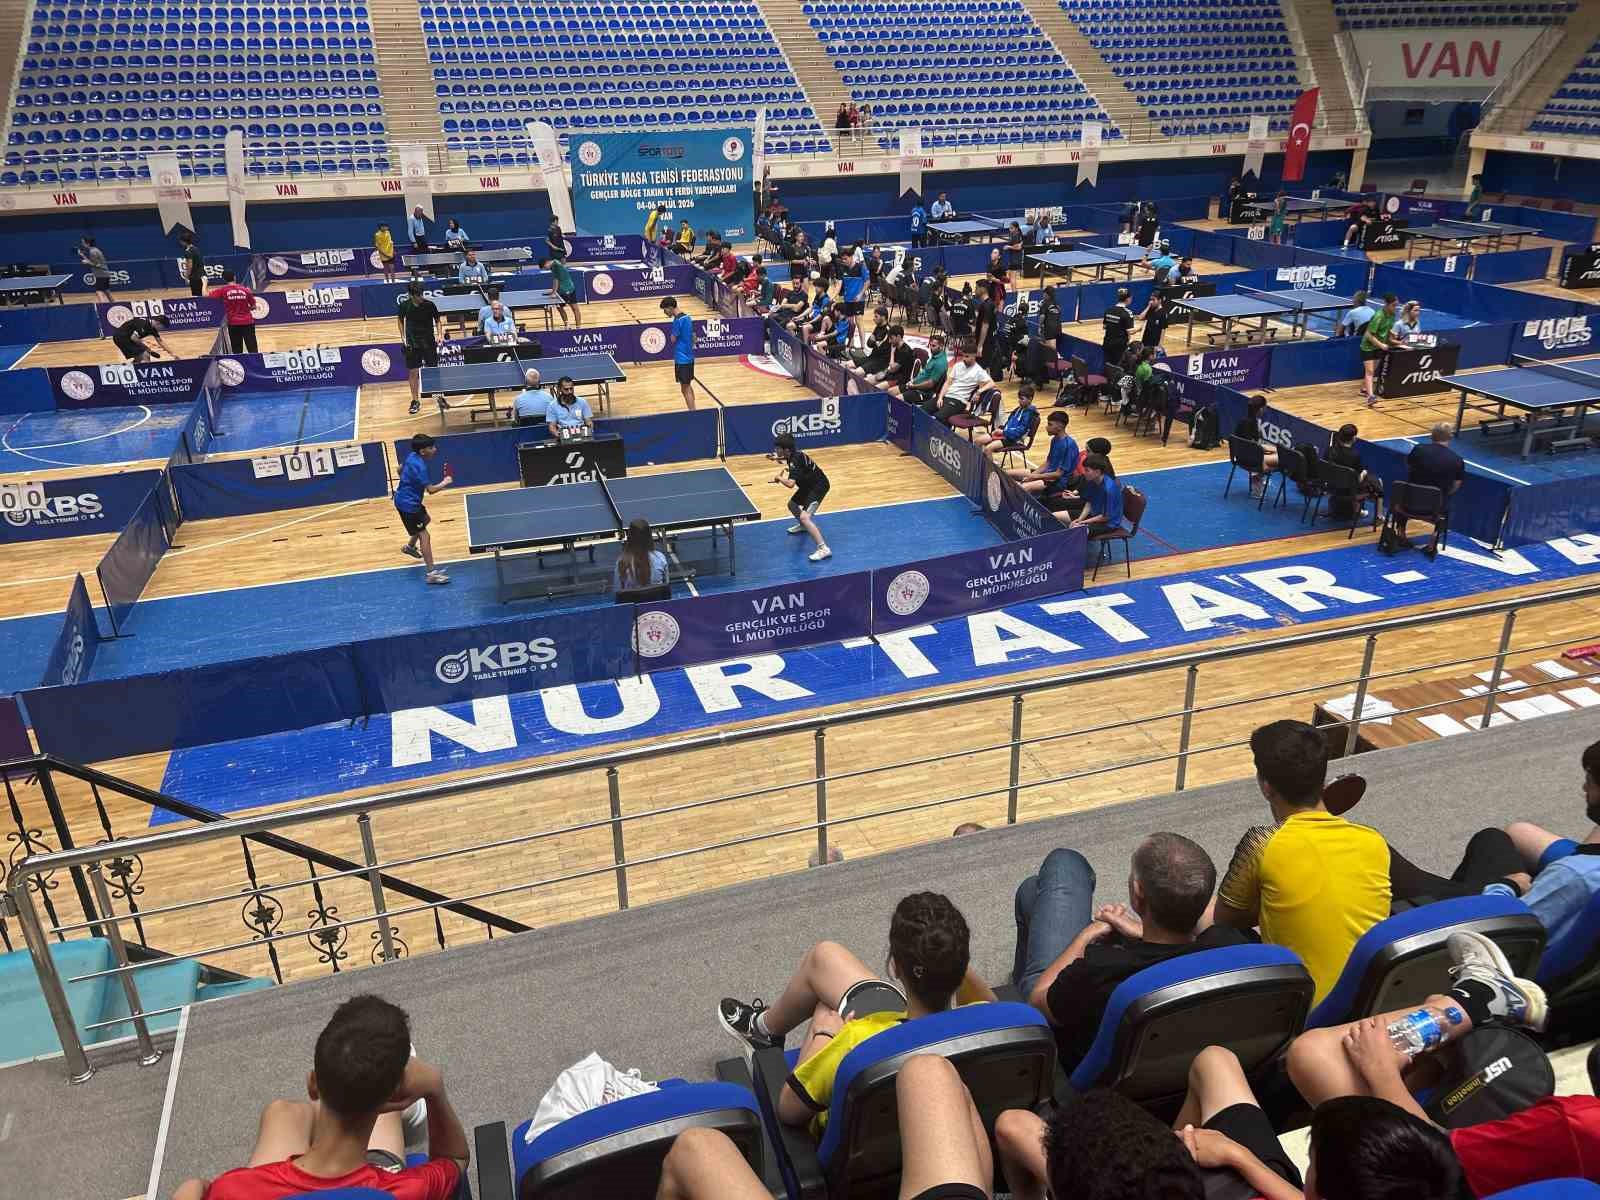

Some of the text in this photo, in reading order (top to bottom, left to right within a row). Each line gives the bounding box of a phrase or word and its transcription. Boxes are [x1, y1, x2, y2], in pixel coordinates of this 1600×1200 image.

[1401, 40, 1501, 78] VAN
[1212, 144, 1227, 153] VAN
[997, 155, 1012, 164] VAN
[838, 162, 854, 172] VAN
[480, 177, 499, 187] VAN
[581, 167, 743, 186] TÜRKİYE MASA TENİSİ FEDERASYONU
[276, 184, 298, 195] VAN
[381, 180, 401, 191] VAN
[591, 184, 737, 201] GENÇLER BÖLGE TAKIM VE FERDİ YARIŞMALARI
[54, 192, 78, 205] VAN
[637, 201, 656, 211] 04-06
[679, 200, 695, 209] 2026
[307, 293, 317, 305] 0
[322, 292, 331, 304] 0
[135, 304, 160, 315] 0 0
[168, 301, 197, 312] VAN
[709, 324, 720, 335] 10
[573, 333, 603, 345] VAN
[728, 334, 745, 345] SPOR
[560, 343, 618, 354] GENÇLİK VE SPOR
[287, 356, 298, 369] 0
[306, 355, 317, 368] 0
[1190, 359, 1201, 373] 5
[1209, 356, 1239, 370] VAN
[105, 368, 134, 383] 0 0
[137, 367, 174, 379] VAN
[285, 371, 334, 382] MÜDÜRLÜĞÜ
[1223, 371, 1232, 379] VE
[1401, 369, 1441, 385] STIGA
[160, 378, 171, 387] VE
[172, 377, 193, 387] SPOR
[128, 384, 190, 396] İL MÜDÜRLÜĞÜ
[826, 403, 836, 417] 9
[936, 441, 961, 471] KBS
[290, 456, 302, 472] 0
[316, 457, 328, 473] 1
[2, 490, 42, 509] 0 0
[35, 493, 104, 519] KBS
[989, 547, 1033, 570] VAN
[966, 561, 1053, 589] GENÇLİK VE SPOR
[970, 573, 1049, 599] İL MÜDÜRLÜĞÜ
[752, 592, 805, 615] VAN
[726, 608, 832, 632] GENÇLİK VE SPOR
[732, 619, 826, 644] İL MÜDÜRLÜĞÜ
[469, 637, 558, 673] KBS
[391, 654, 816, 767] NUR
[841, 566, 1384, 679] TATAR
[472, 667, 527, 681] TABLE TENNIS
[1484, 1056, 1513, 1083] UST
